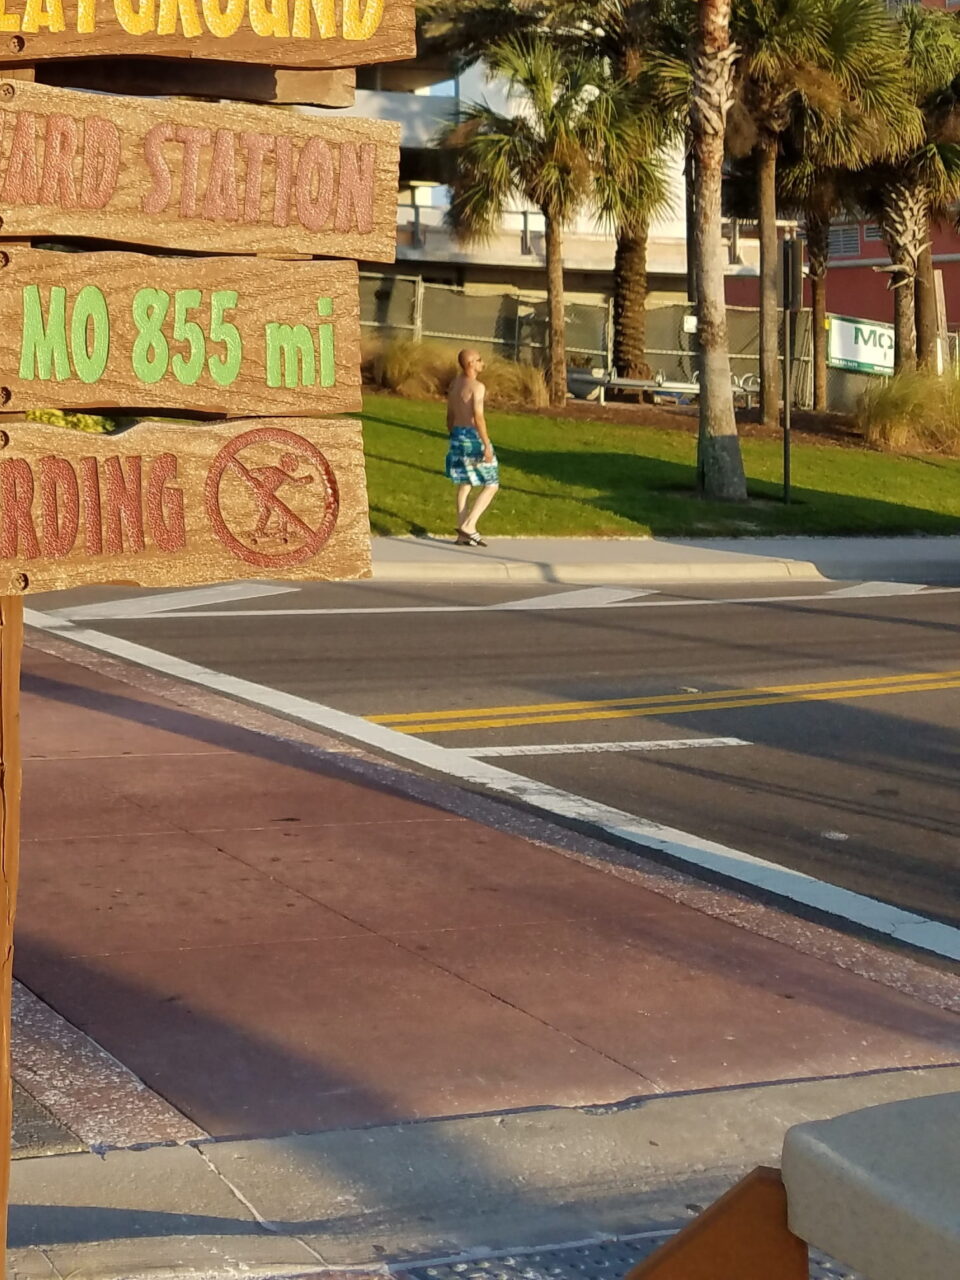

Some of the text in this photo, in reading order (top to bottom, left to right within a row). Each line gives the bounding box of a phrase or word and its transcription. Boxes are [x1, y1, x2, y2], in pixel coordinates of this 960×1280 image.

[141, 123, 378, 236] STATION
[19, 285, 109, 384] MO
[132, 288, 242, 386] 855
[266, 297, 335, 389] mi
